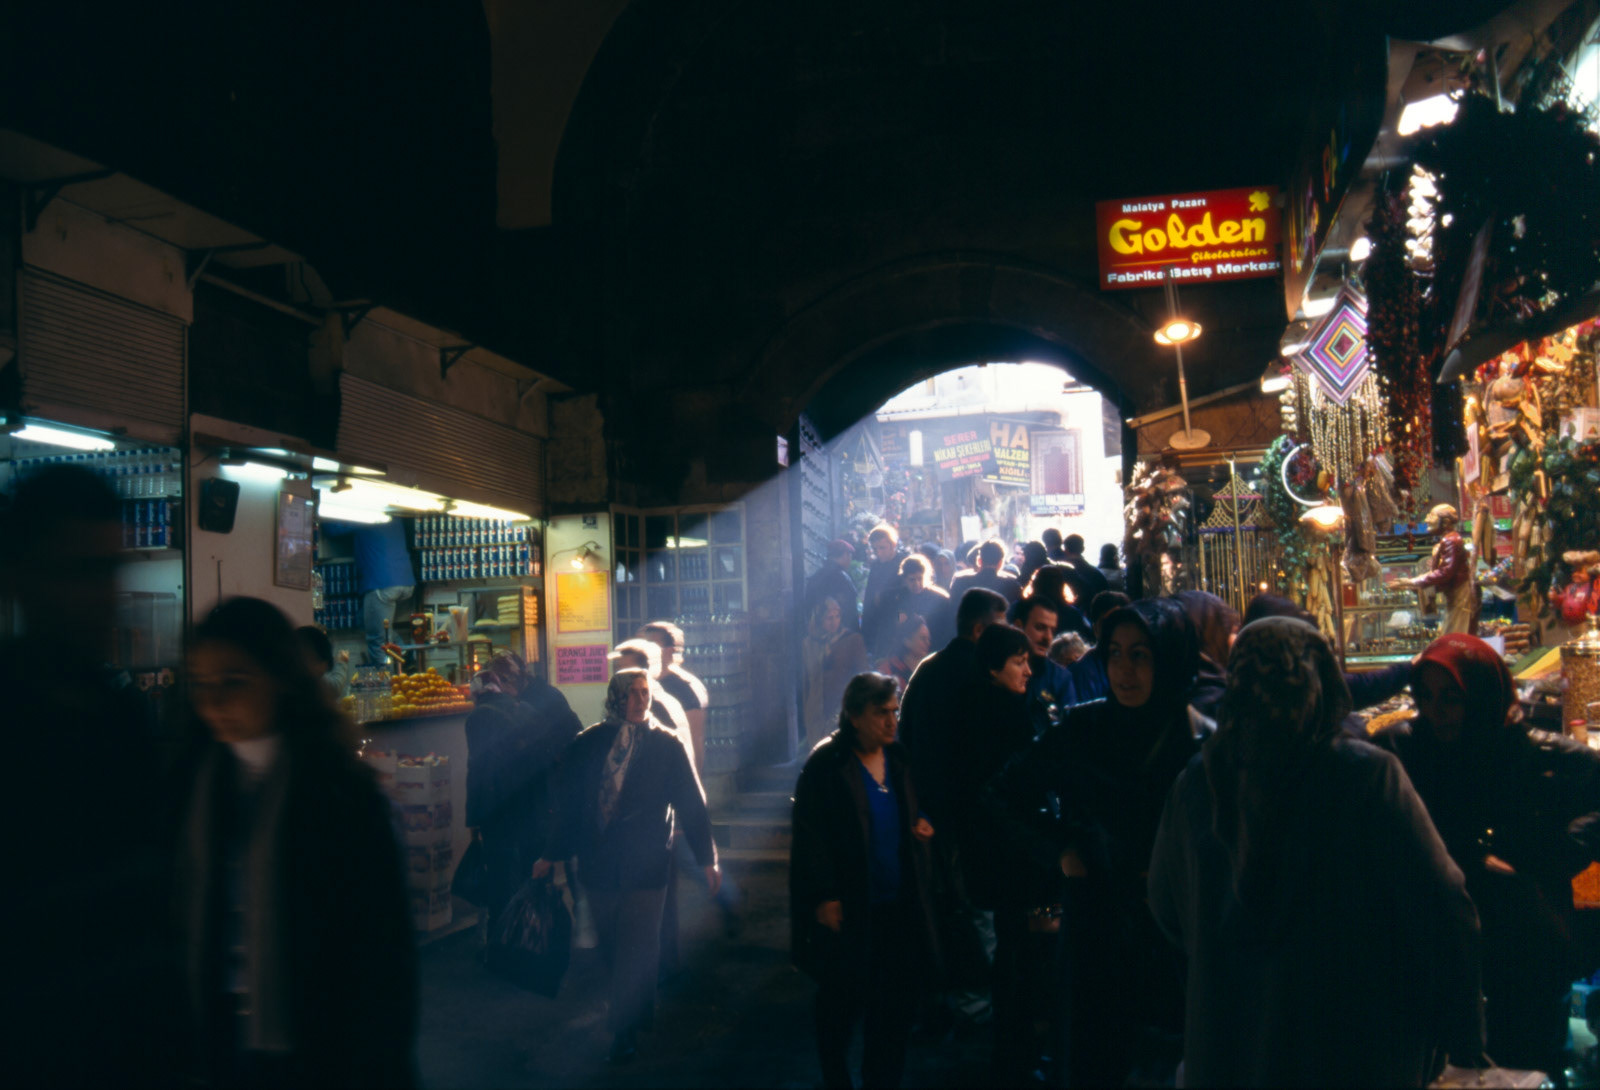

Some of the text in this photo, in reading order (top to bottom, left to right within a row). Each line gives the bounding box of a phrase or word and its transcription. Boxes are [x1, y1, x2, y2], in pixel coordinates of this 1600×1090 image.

[1122, 202, 1165, 213] Malatya
[1108, 211, 1267, 255] Golden
[1107, 269, 1165, 284] Fabrika
